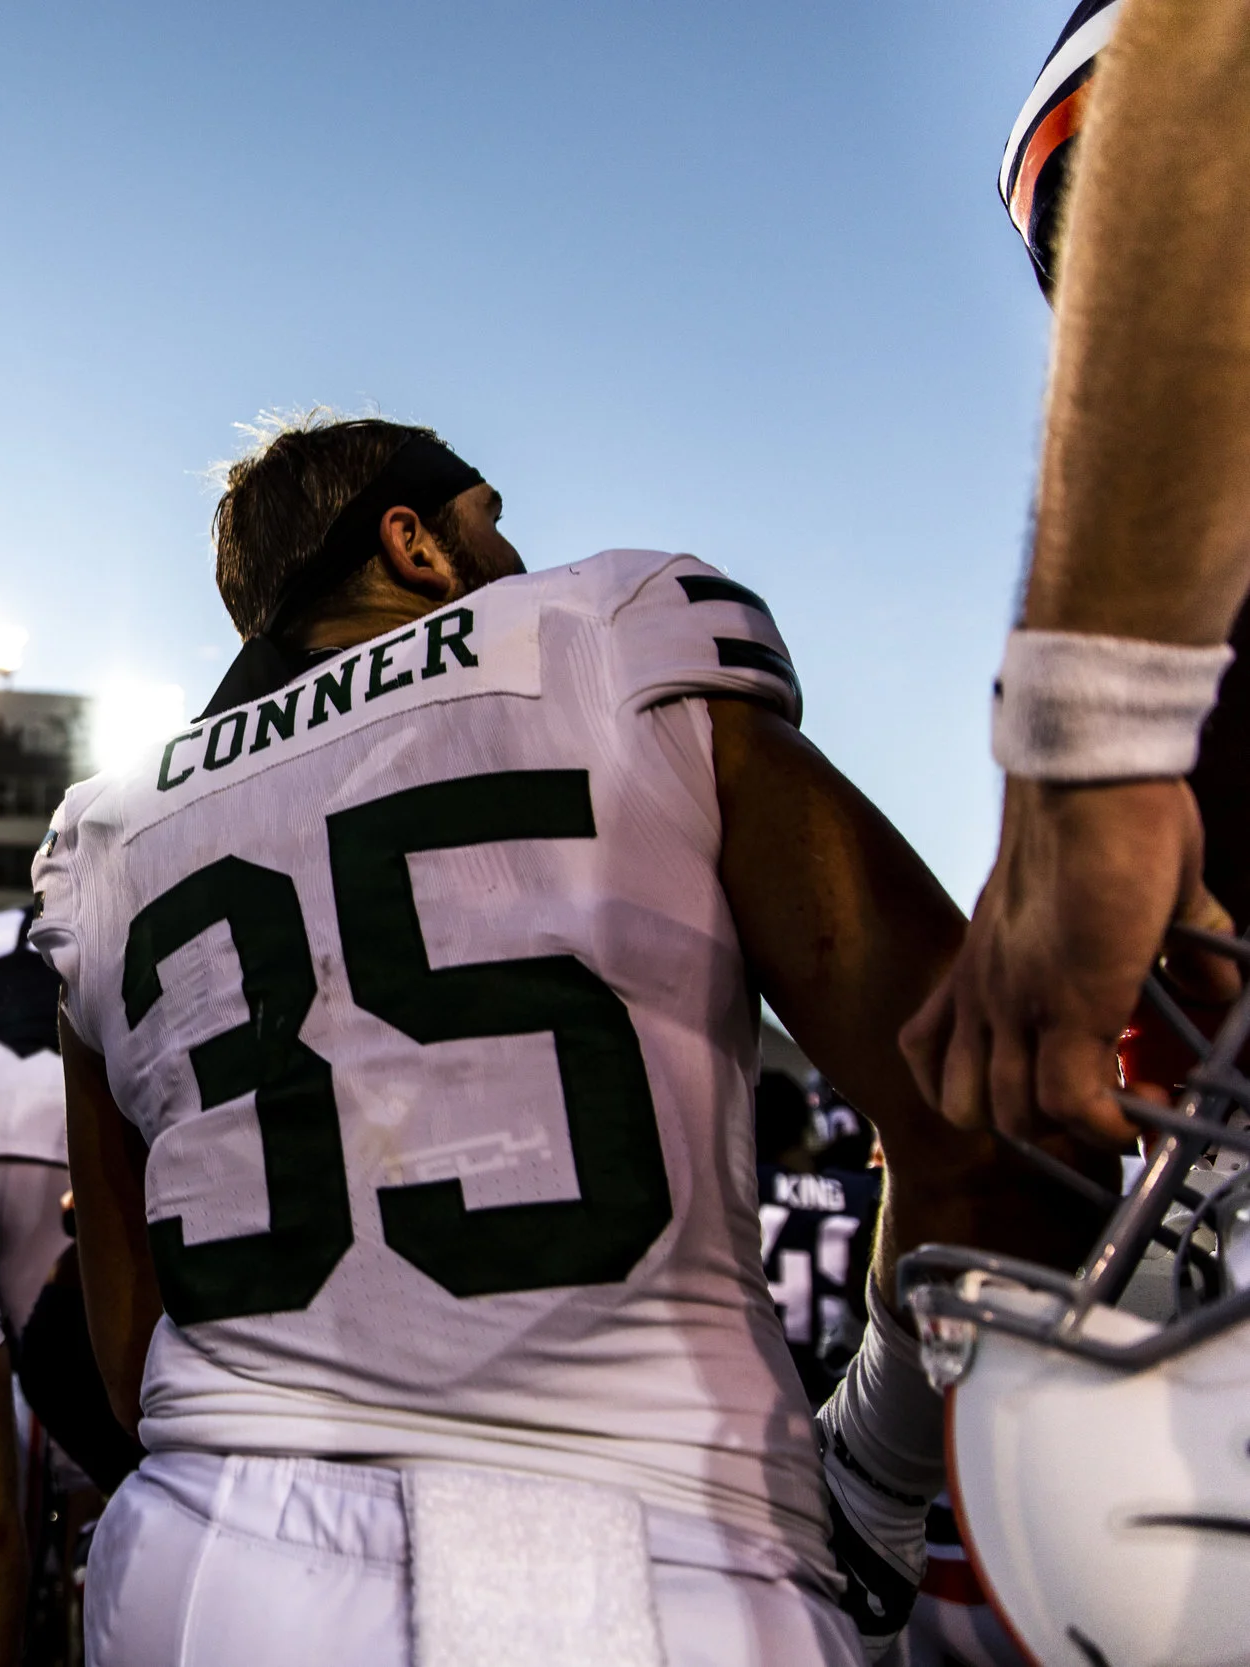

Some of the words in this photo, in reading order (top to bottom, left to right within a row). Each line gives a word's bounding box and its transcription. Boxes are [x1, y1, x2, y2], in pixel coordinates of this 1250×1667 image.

[156, 606, 479, 792] CONNER
[121, 769, 673, 1328] 35
[772, 1171, 846, 1212] KING
